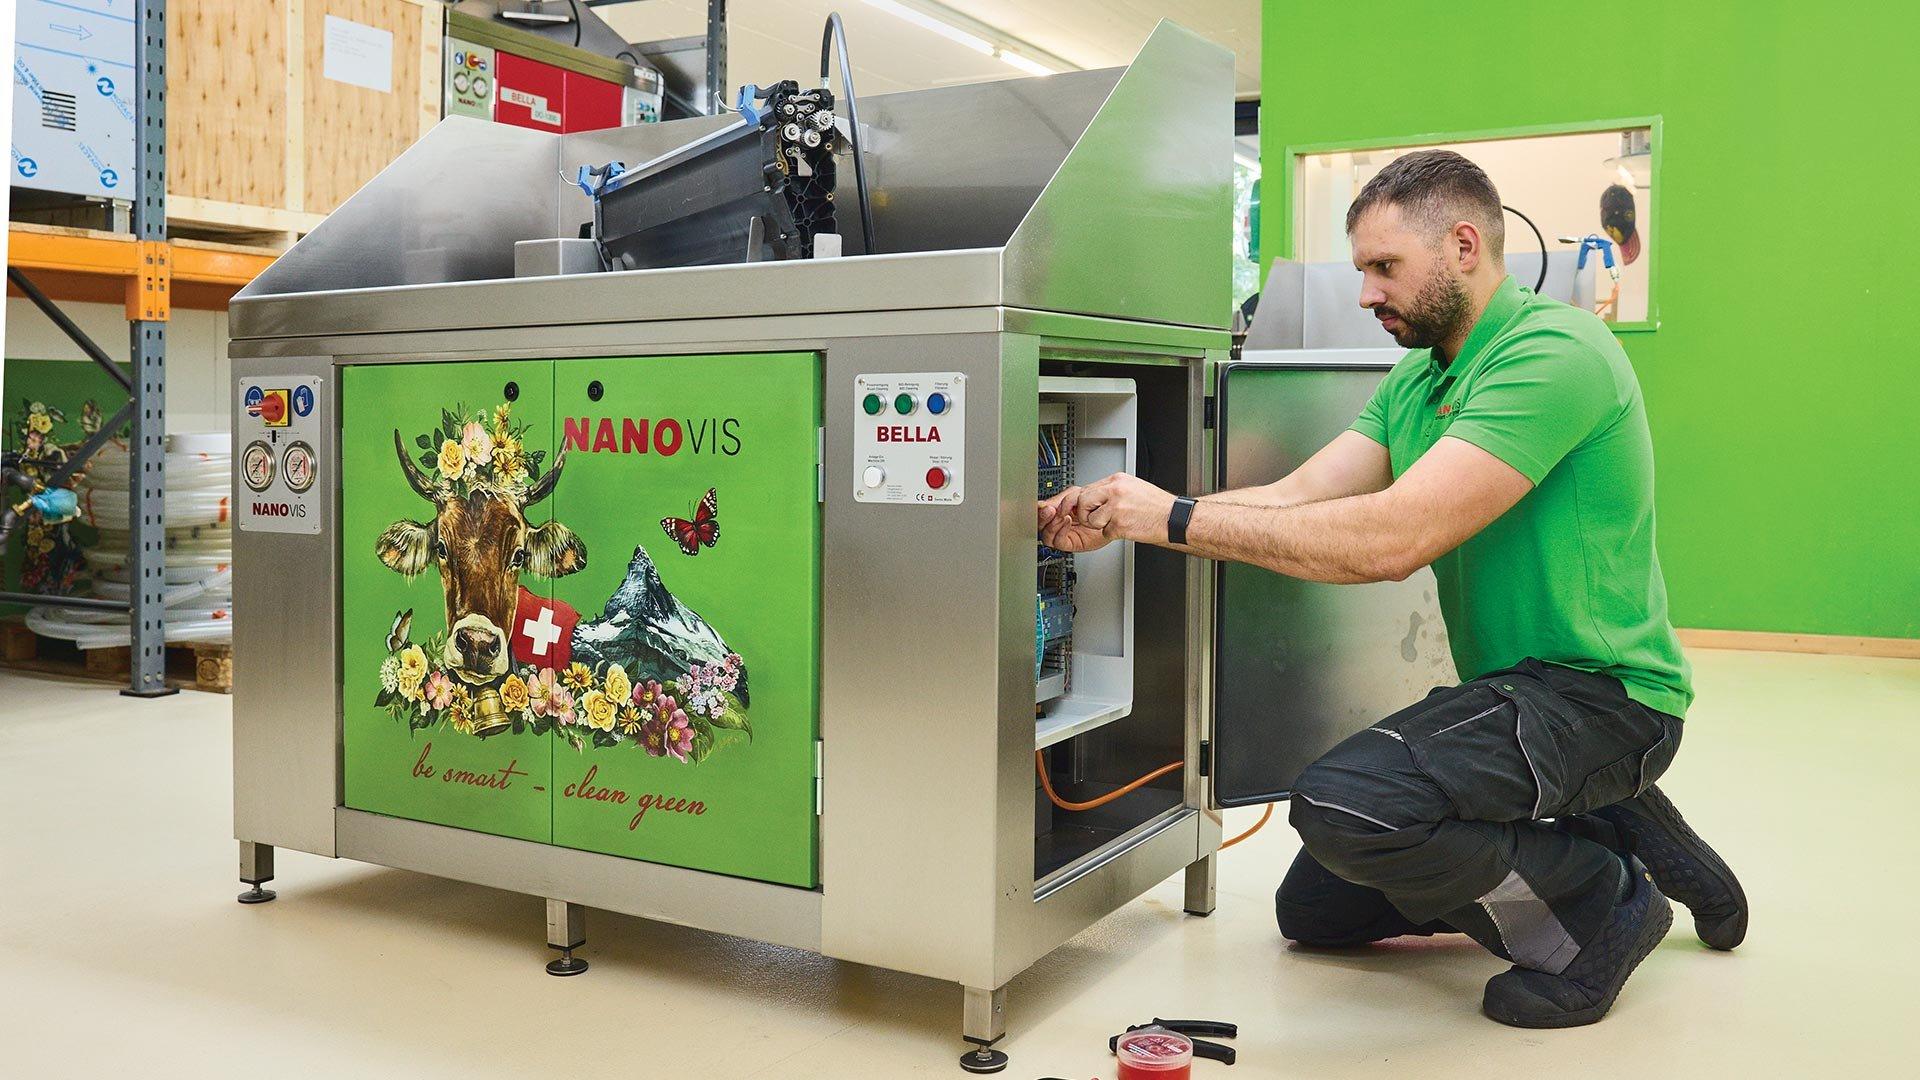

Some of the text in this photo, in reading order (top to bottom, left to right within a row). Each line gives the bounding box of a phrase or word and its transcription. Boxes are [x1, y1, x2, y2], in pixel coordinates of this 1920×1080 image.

[511, 91, 537, 106] BELLA
[564, 416, 742, 457] NANOVIS
[876, 425, 942, 443] BELLA
[252, 502, 307, 518] NANOVIS
[411, 742, 437, 778] be
[442, 759, 529, 791] smart
[563, 764, 631, 804] clean
[629, 791, 708, 831] green
